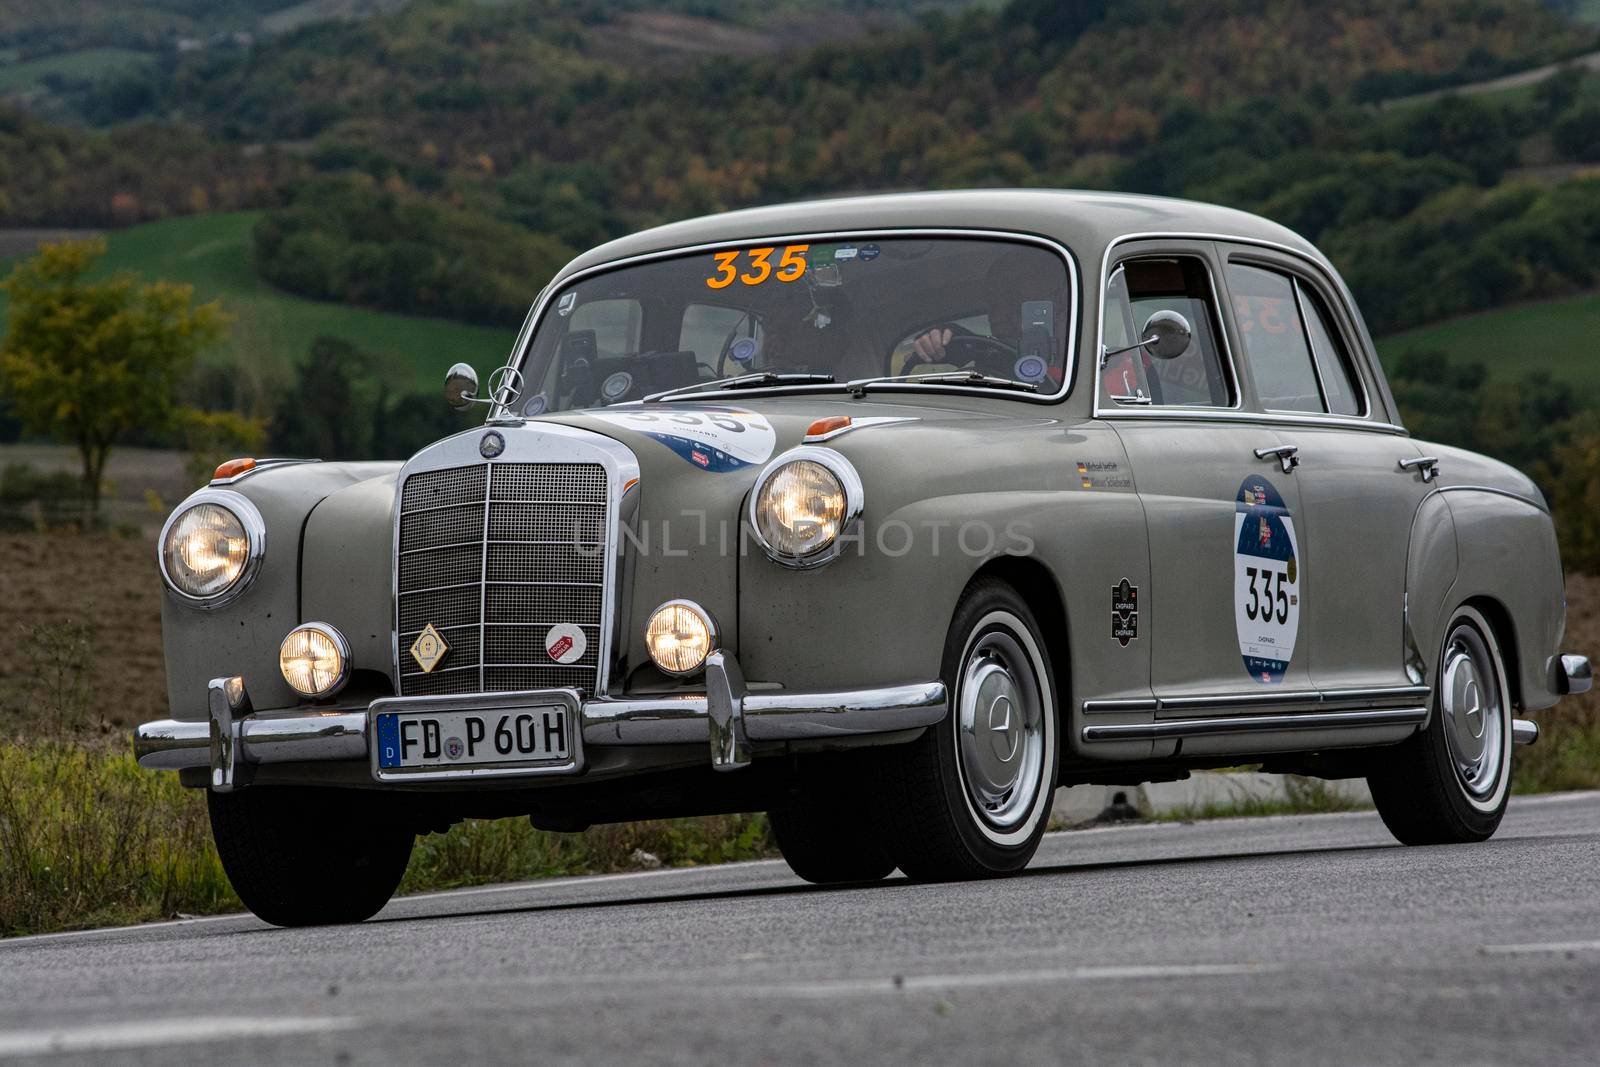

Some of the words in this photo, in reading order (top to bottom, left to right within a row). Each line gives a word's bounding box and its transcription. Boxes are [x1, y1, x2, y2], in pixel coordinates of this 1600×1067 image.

[707, 244, 809, 289] 335
[1246, 567, 1288, 625] 335
[1115, 602, 1135, 610] CHOPARD
[1115, 629, 1134, 637] CHOPARD
[551, 640, 565, 653] 1000
[400, 718, 442, 760] FD
[386, 747, 394, 758] D
